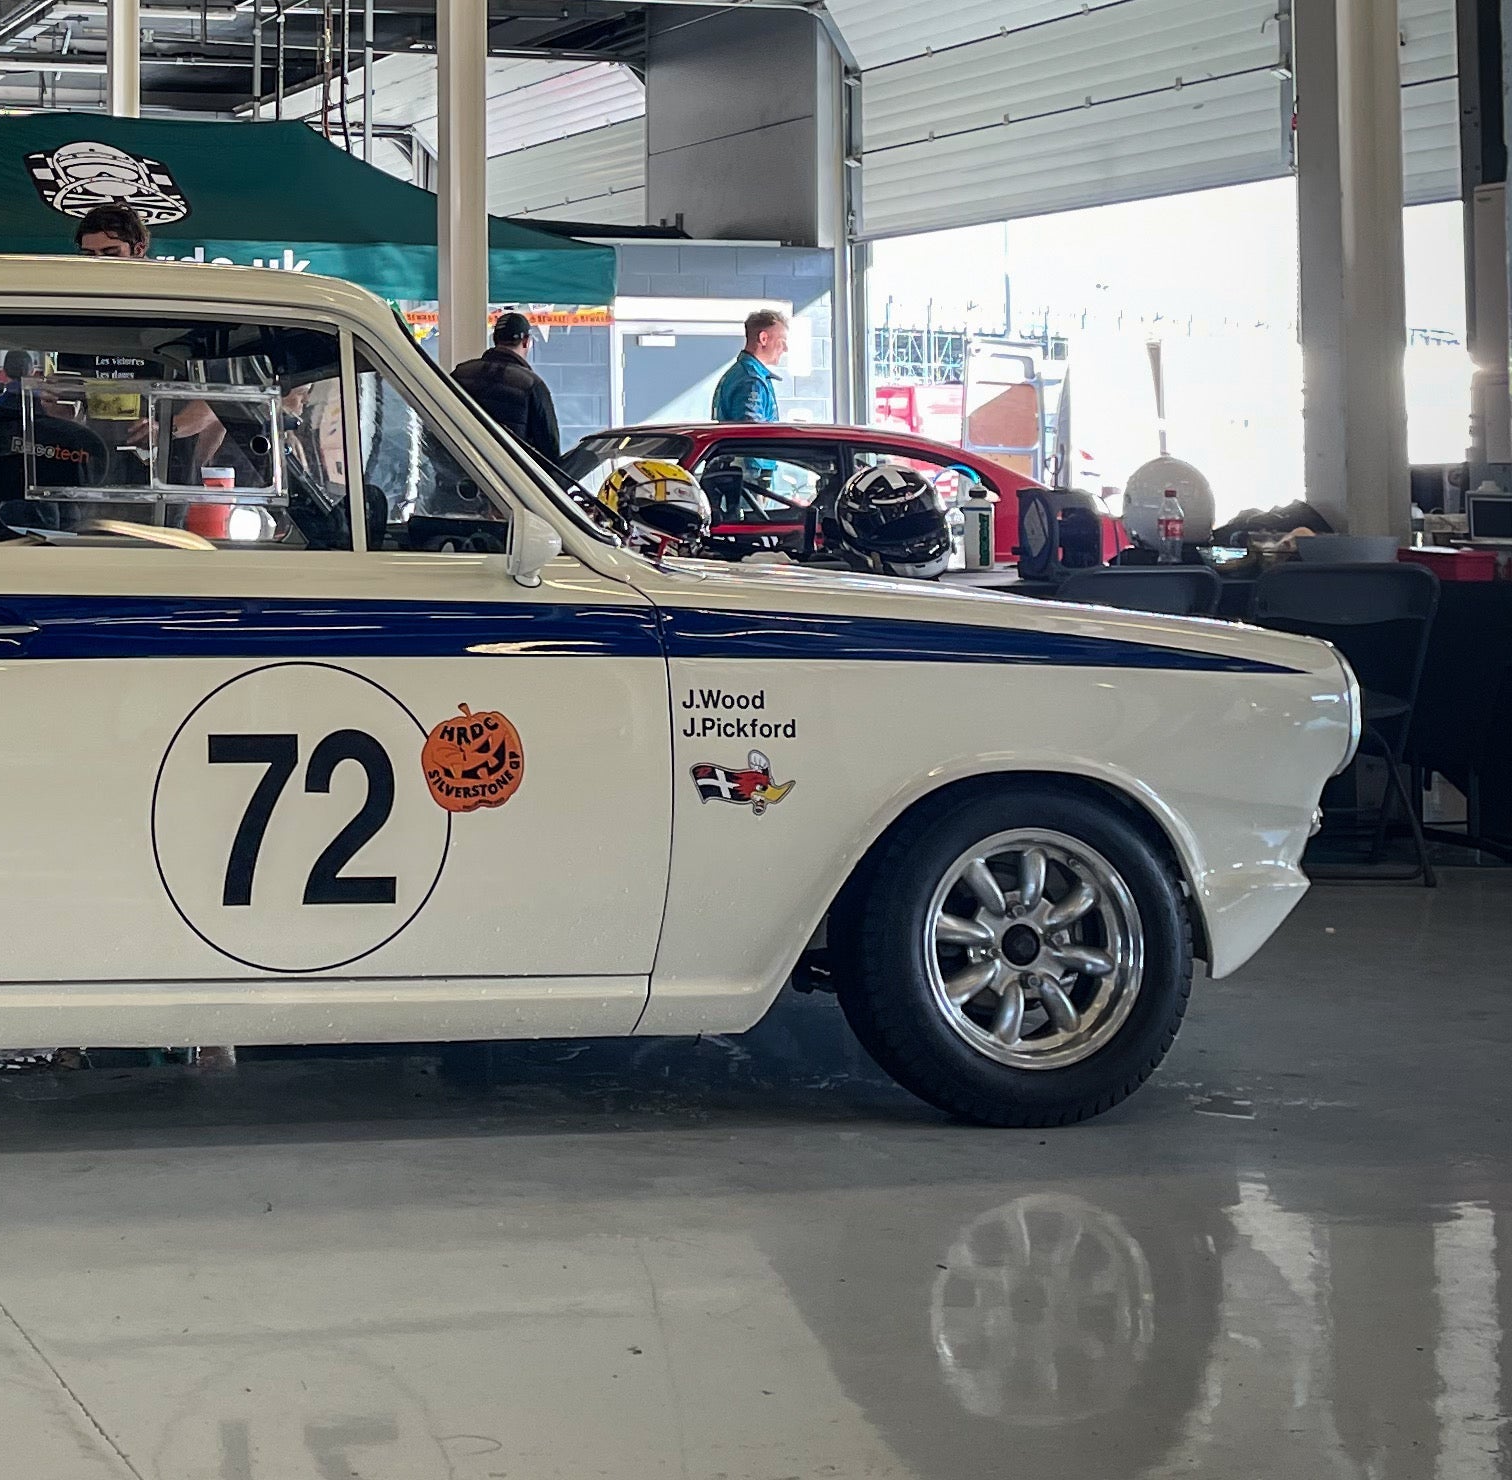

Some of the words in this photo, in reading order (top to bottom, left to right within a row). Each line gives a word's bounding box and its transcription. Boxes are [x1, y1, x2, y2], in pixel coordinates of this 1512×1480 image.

[682, 689, 765, 709] J.Wood
[439, 716, 499, 746] HRDC
[682, 717, 796, 738] J.Pickford
[428, 769, 514, 798] SILVERSTONE
[208, 729, 397, 906] 72
